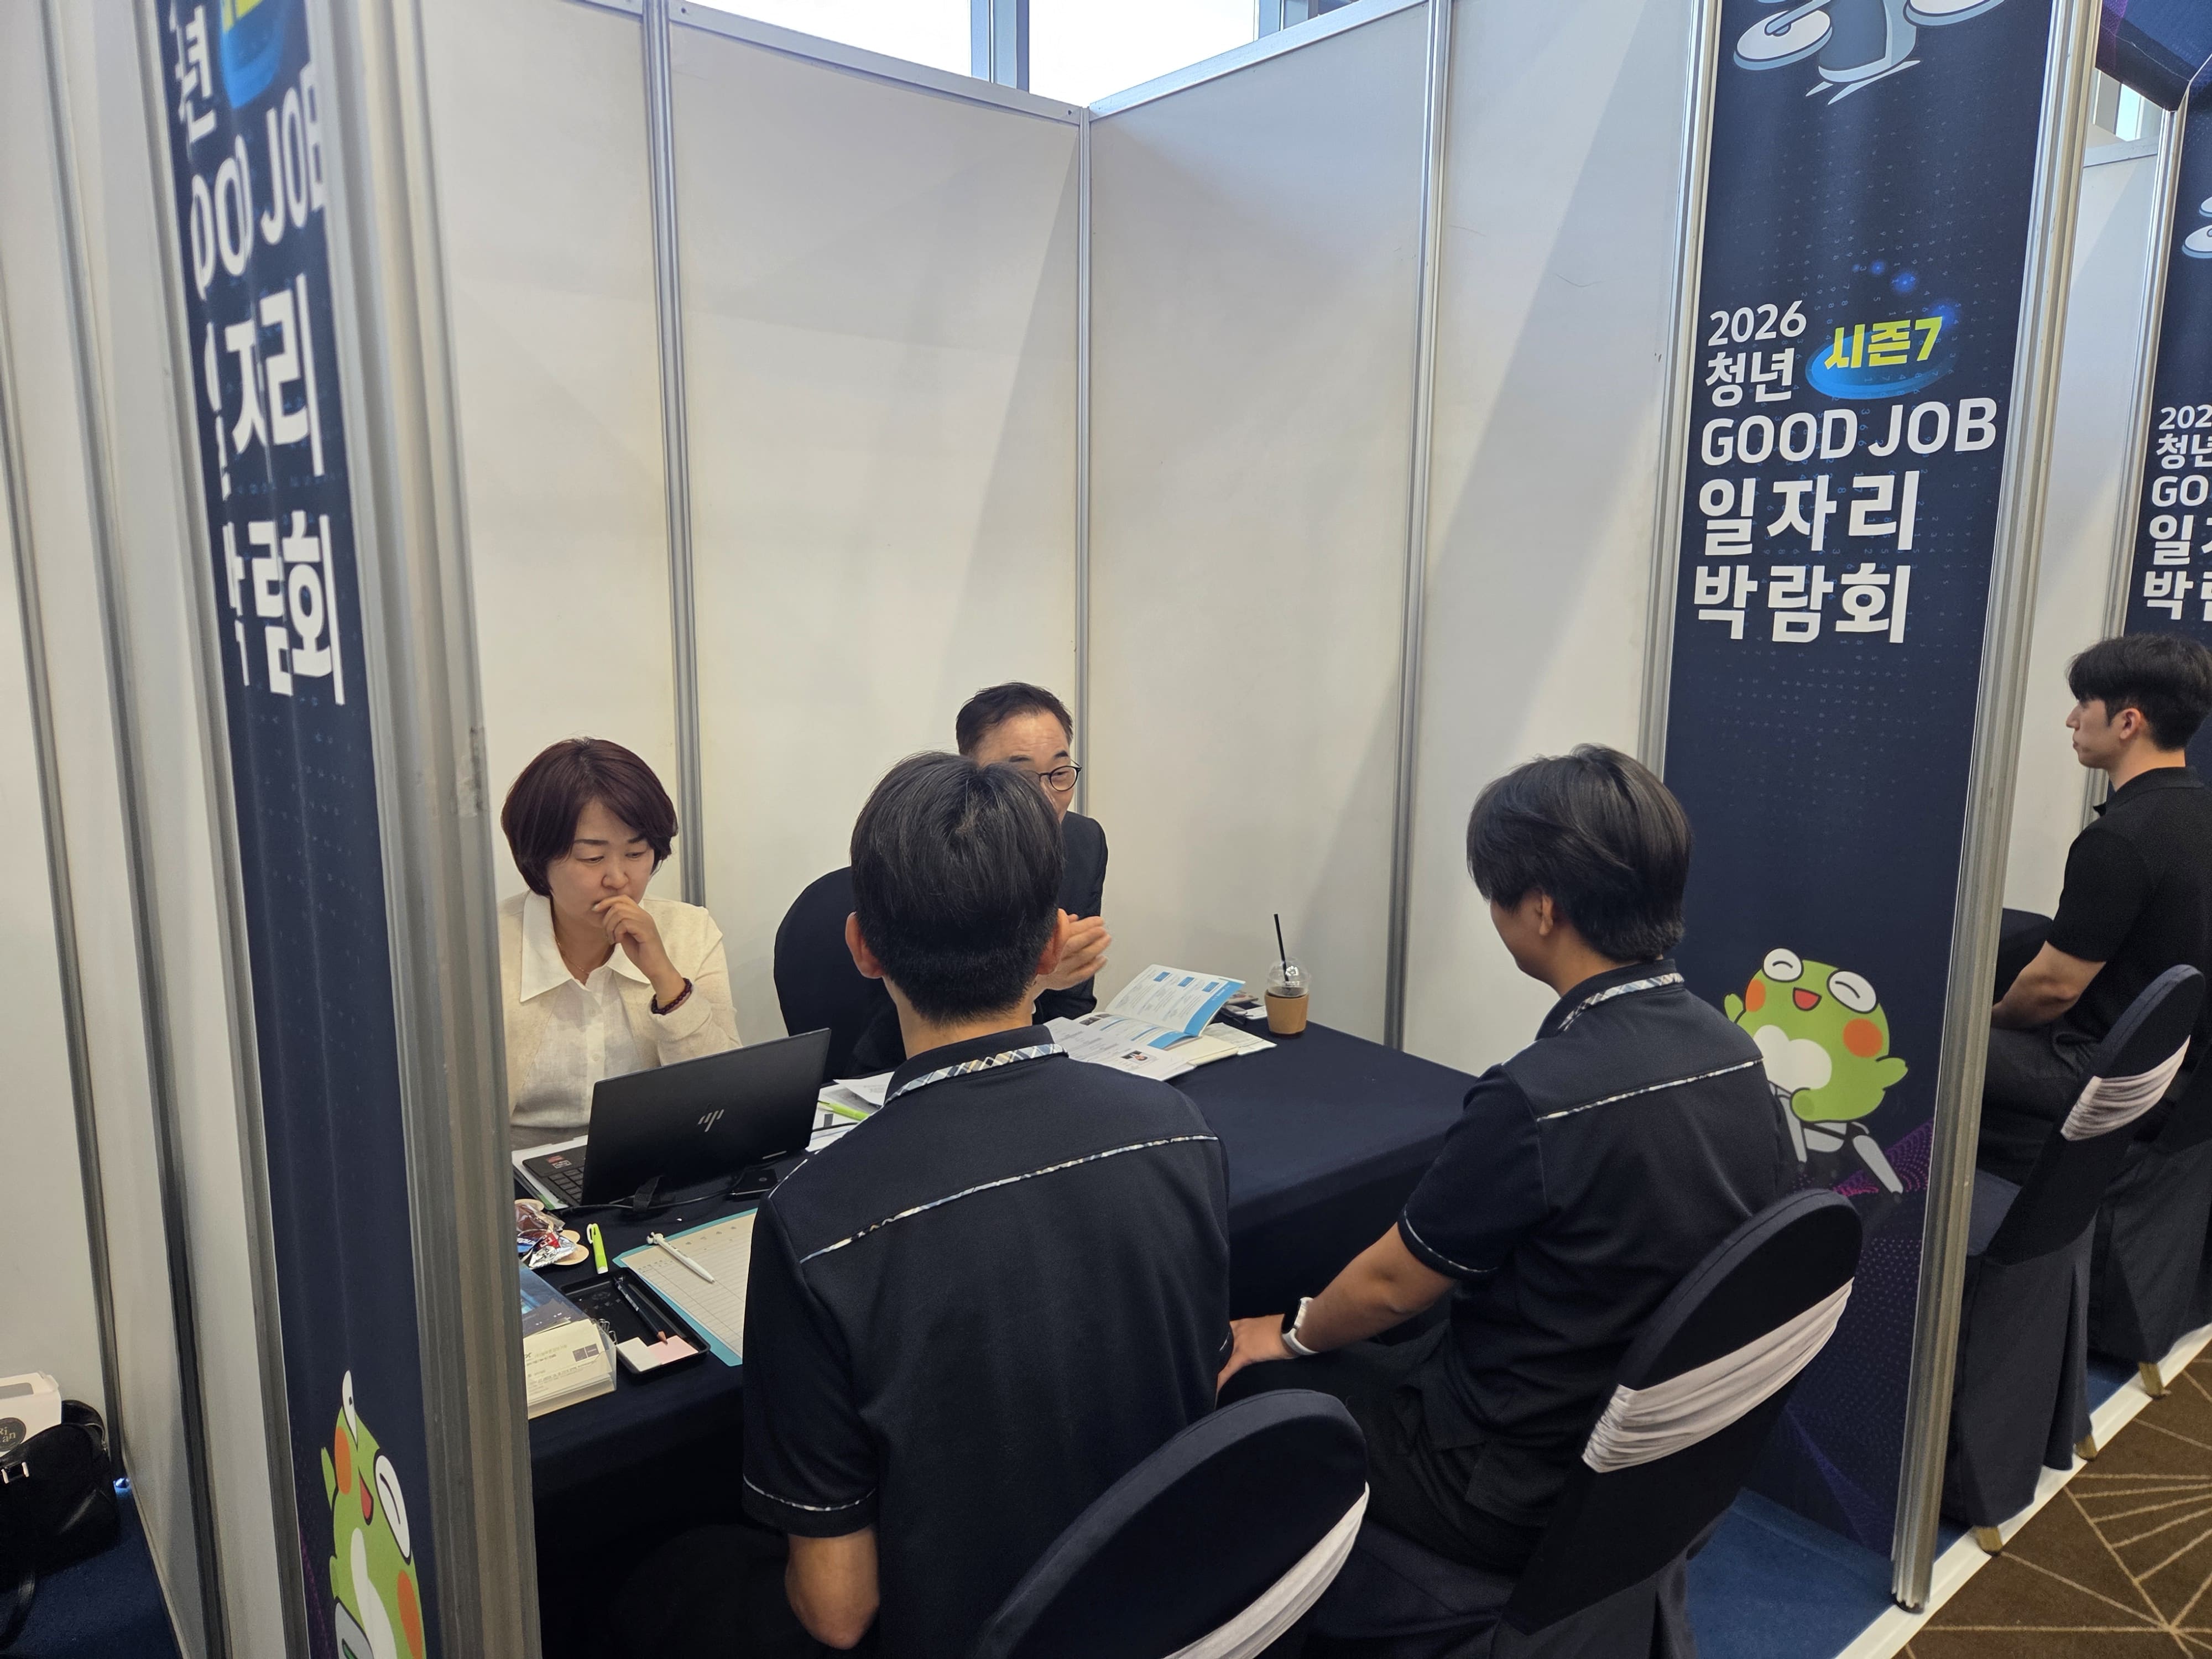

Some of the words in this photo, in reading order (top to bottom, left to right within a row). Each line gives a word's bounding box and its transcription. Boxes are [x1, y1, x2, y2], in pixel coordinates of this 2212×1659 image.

[1708, 300, 1807, 346] 2026
[1824, 316, 1943, 370] 시즌7
[1705, 347, 1794, 408] 청년
[1700, 408, 1858, 466] GOOD
[1868, 397, 1997, 457] JOB
[2159, 404, 2212, 430] 202
[1698, 470, 1920, 556] 일자리
[222, 510, 345, 706] 람회
[1694, 562, 1911, 644] 박람회
